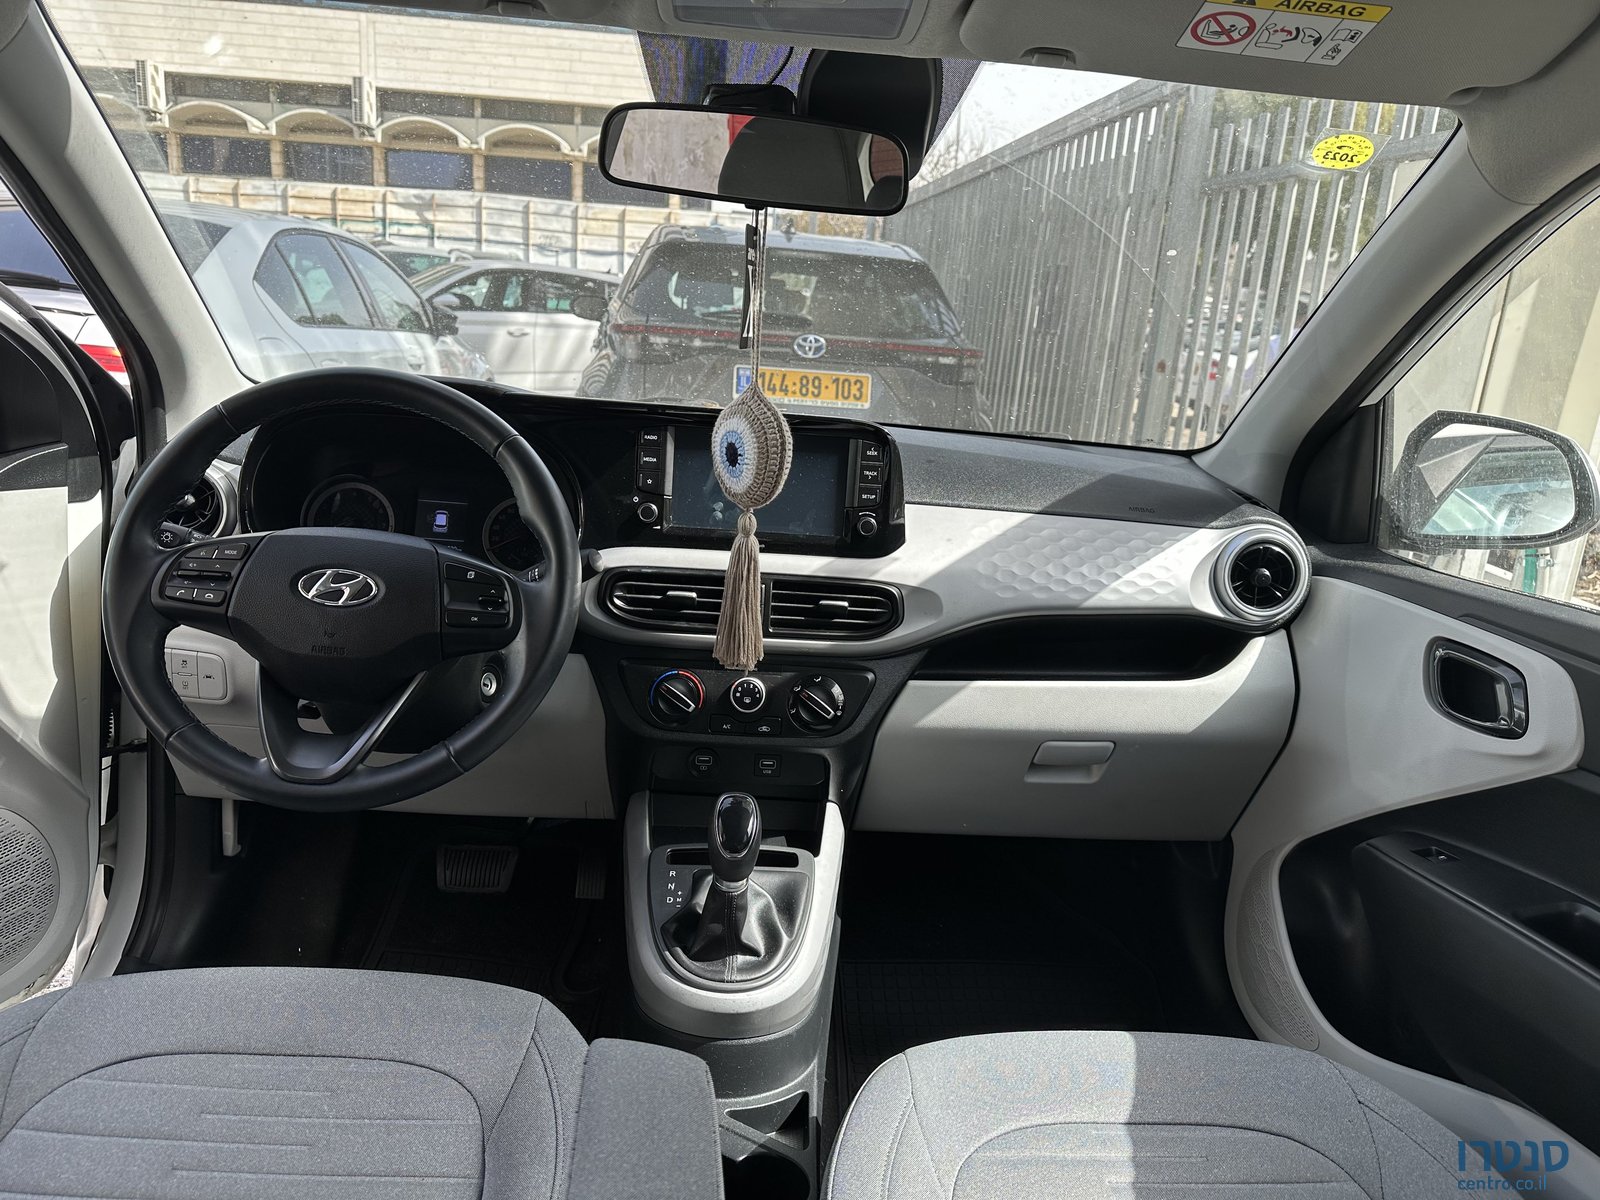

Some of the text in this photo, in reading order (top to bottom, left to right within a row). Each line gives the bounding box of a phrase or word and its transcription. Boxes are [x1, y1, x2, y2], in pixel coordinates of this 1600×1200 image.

[1274, 0, 1367, 17] AIRBAG
[667, 882, 675, 890] N
[666, 896, 674, 904] D
